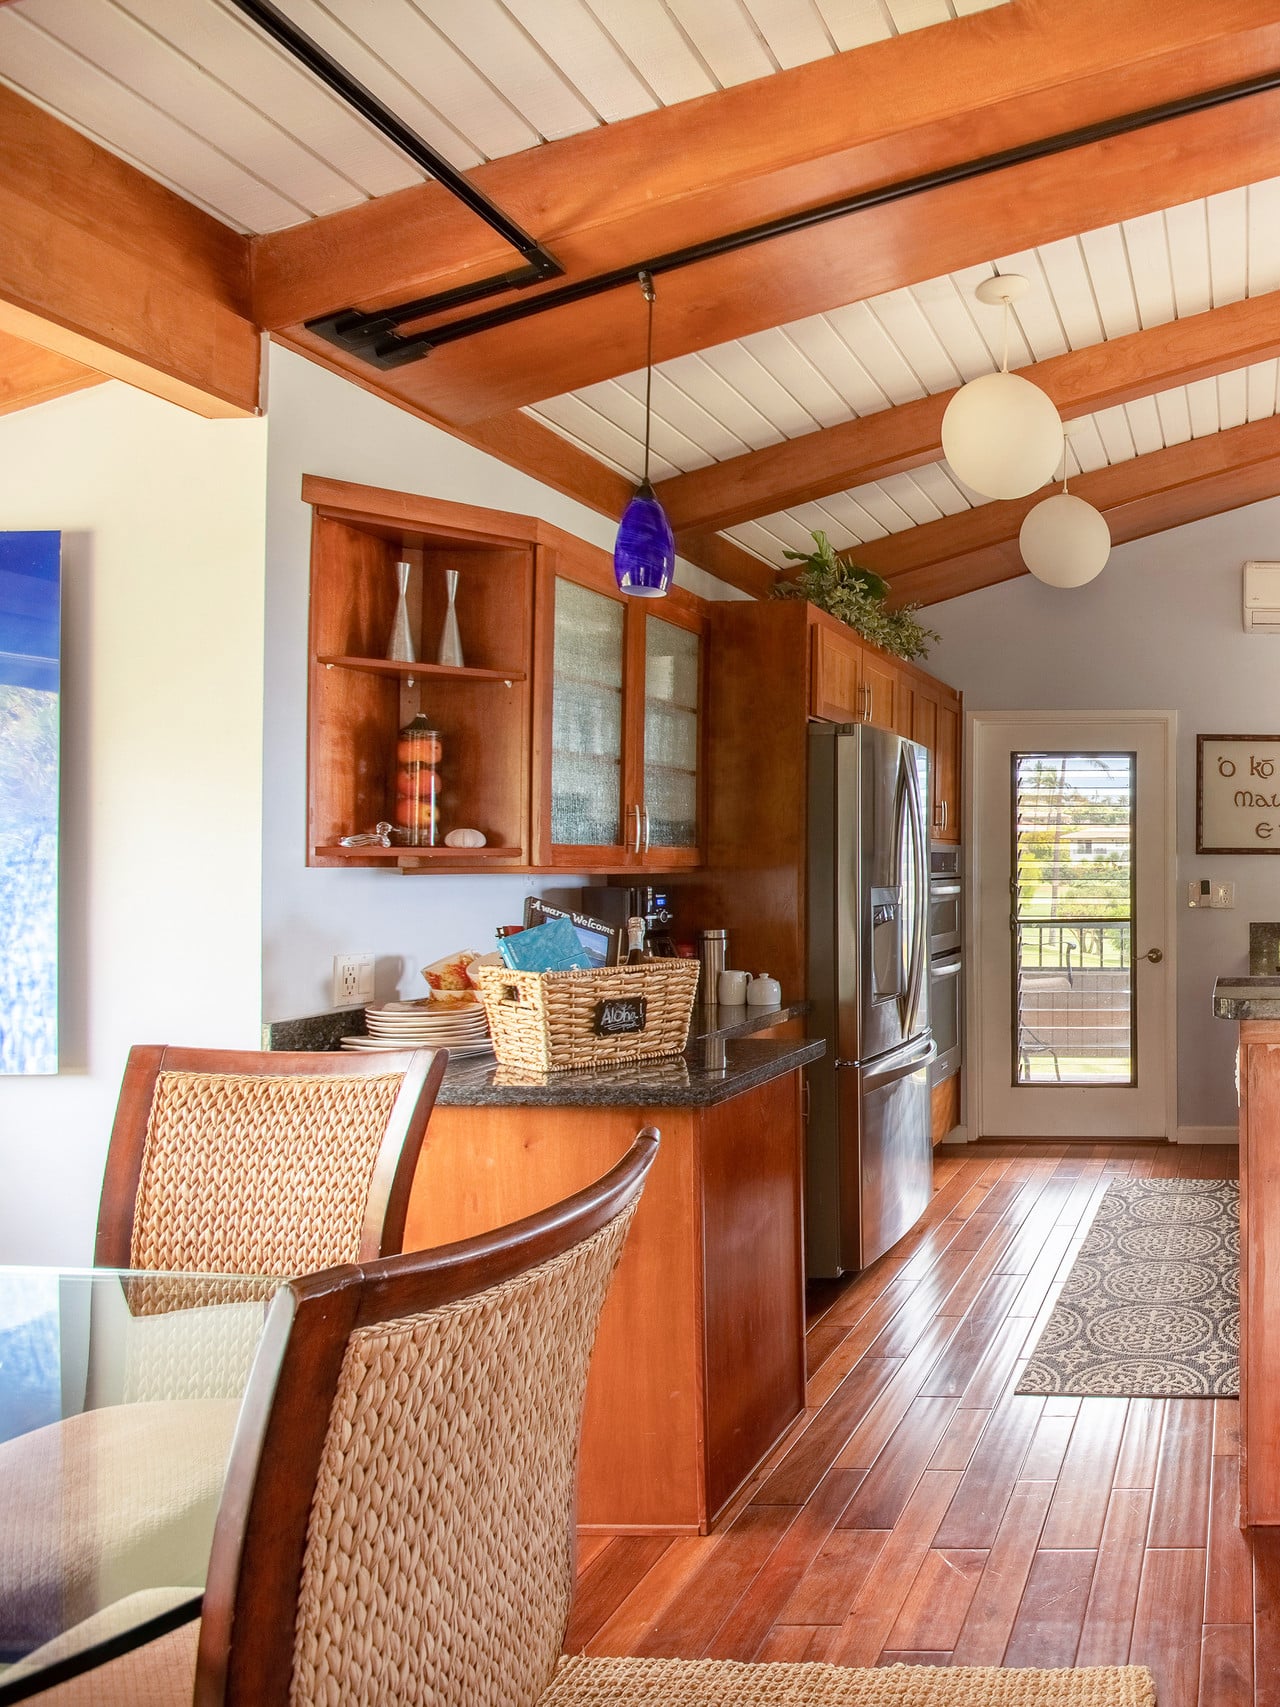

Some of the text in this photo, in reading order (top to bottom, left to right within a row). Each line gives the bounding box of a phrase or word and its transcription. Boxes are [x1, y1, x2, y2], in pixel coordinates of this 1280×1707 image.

[1249, 755, 1275, 779] kō
[530, 901, 615, 935] A warm Welcome
